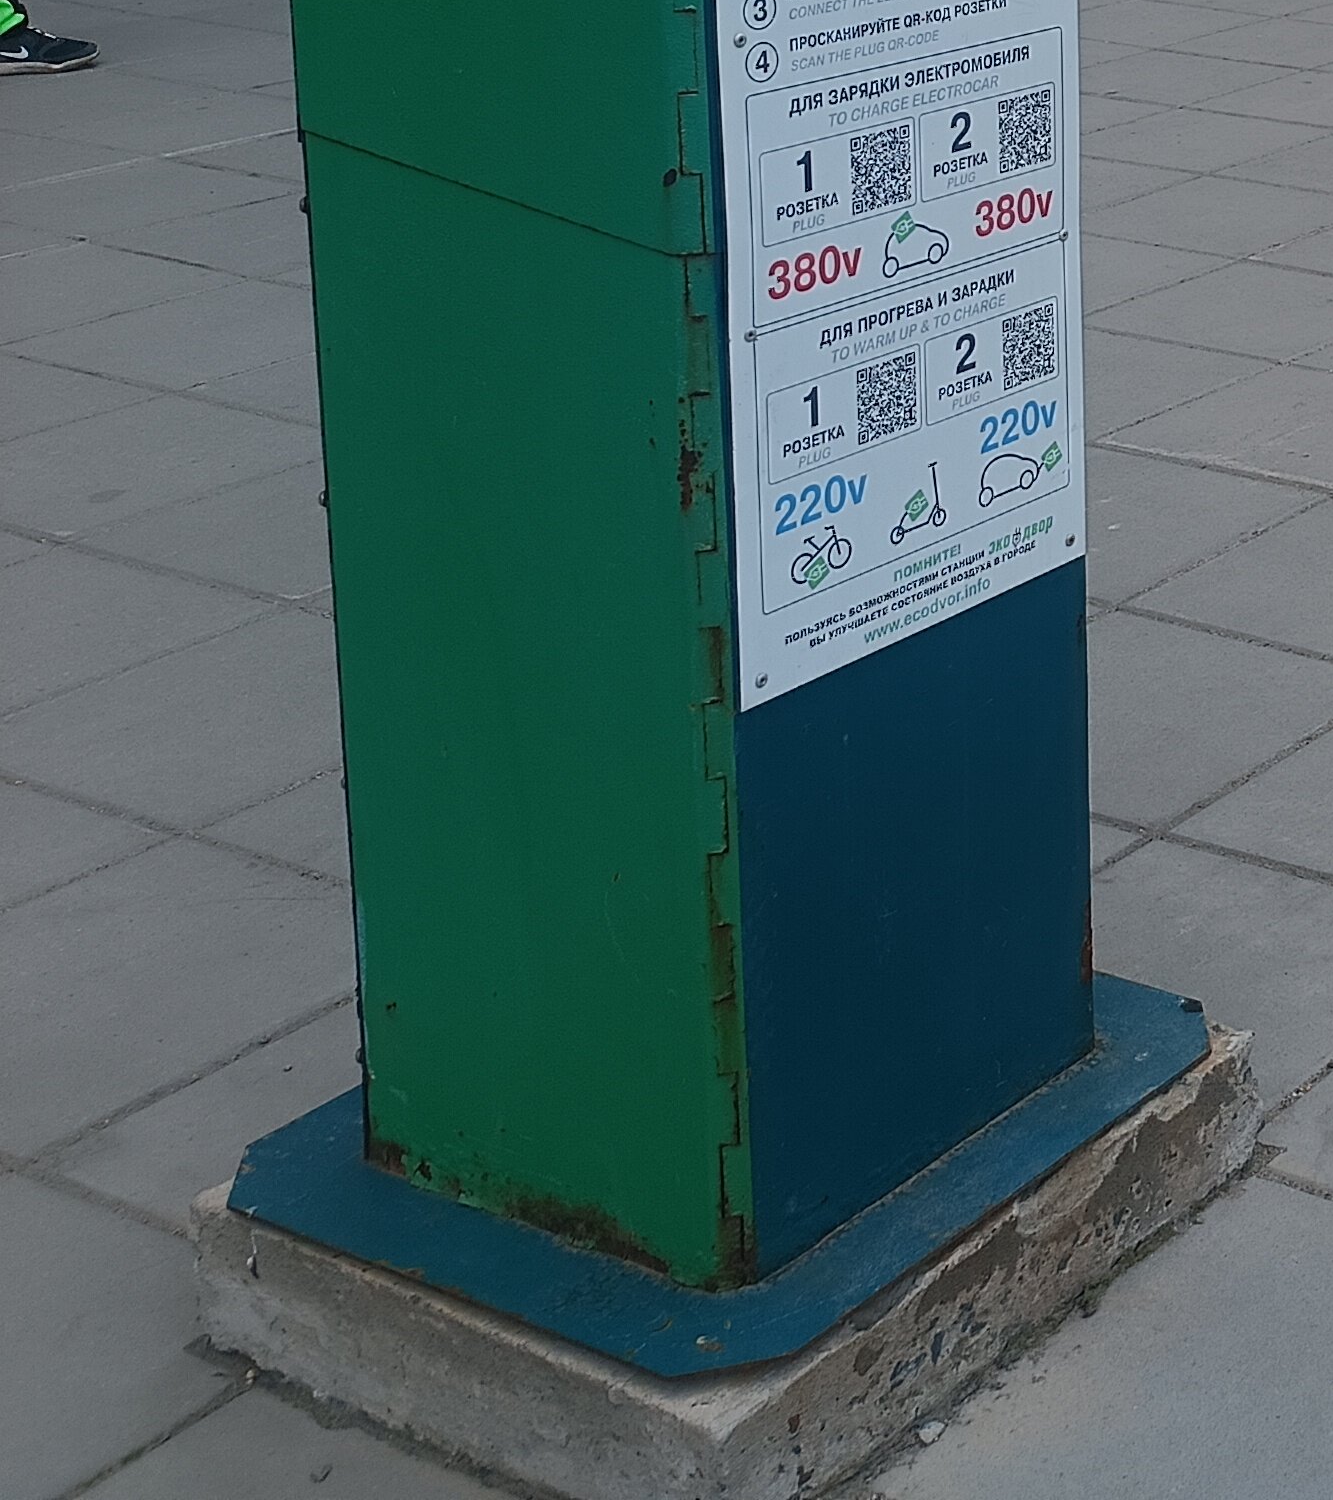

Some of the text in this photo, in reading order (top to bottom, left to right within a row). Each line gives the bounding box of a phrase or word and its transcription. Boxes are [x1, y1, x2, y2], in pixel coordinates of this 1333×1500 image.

[789, 17, 901, 52] ПРОСКАНИРУЙТЕ
[903, 7, 951, 28] QR-КОД
[755, 50, 770, 74] 4
[791, 30, 940, 72] SCAN THE PLUG QR-CODE
[789, 45, 1030, 118] ДЛЯ ЗАРЯДКИ ЭЛЕКТРОМОБИЛЯ
[828, 75, 1000, 128] TO CHARGE ELECTROCAR
[950, 111, 972, 153] 2
[796, 150, 813, 193] 1
[933, 152, 989, 178] РОЗЕТКА
[947, 171, 976, 190] PLUG
[776, 192, 840, 221] РОЗЕТКА
[792, 213, 825, 233] PLUG
[820, 326, 853, 349] ДЛЯ
[858, 299, 934, 334] ПРОГРЕВА
[937, 291, 948, 307] И
[831, 293, 1006, 363] TO WARM UP & TO CHARGE
[955, 332, 977, 375] 2
[803, 385, 820, 428] 1
[938, 370, 993, 401] РОЗЕТКА
[952, 390, 981, 411] PLUG
[783, 425, 845, 458] РОЗЕТКА
[799, 447, 831, 469] PLUG
[893, 543, 962, 583] ПОМНИТЕ!
[785, 612, 847, 645] ПОЛЬЗУЯСЬ
[849, 572, 940, 618] ВОЗМОЖНОСТЯМИ
[941, 550, 985, 578] СТАНЦИИ
[809, 539, 1037, 649] ВЫ УЛУЧШАЕТЕ СОСТОЯНИЕ ВОЗДУХА В ГОРОДЕ
[864, 577, 991, 644] www.ecodvor.info
